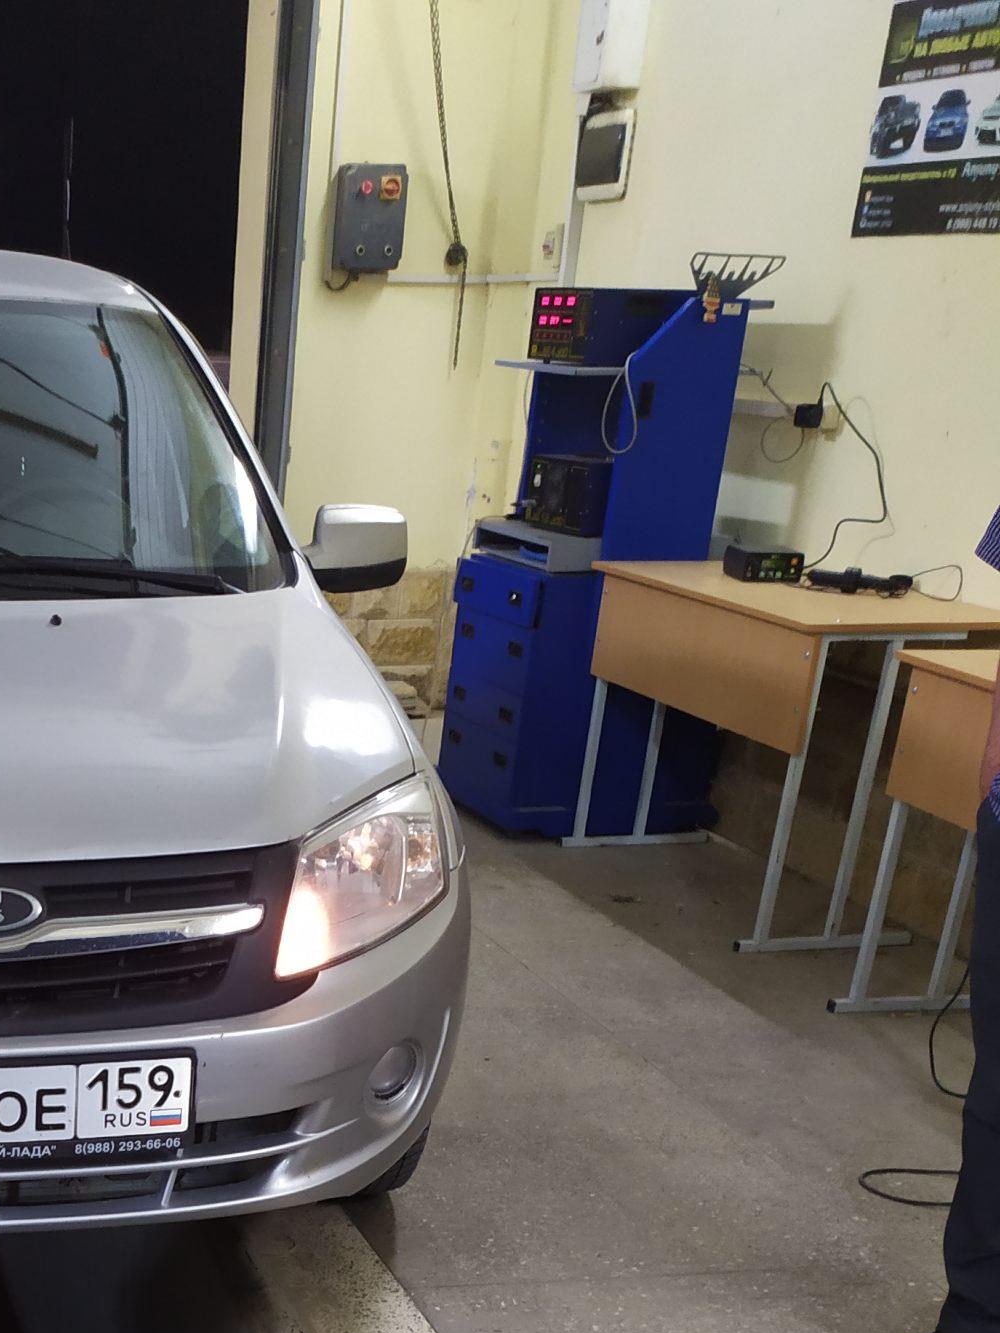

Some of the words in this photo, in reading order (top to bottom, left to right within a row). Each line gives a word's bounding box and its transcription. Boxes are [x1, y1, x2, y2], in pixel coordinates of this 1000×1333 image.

[86, 1065, 175, 1112] 159
[104, 1111, 147, 1129] RUS
[74, 1140, 115, 1155] 8(988)
[118, 1137, 181, 1152] 293-66-06
